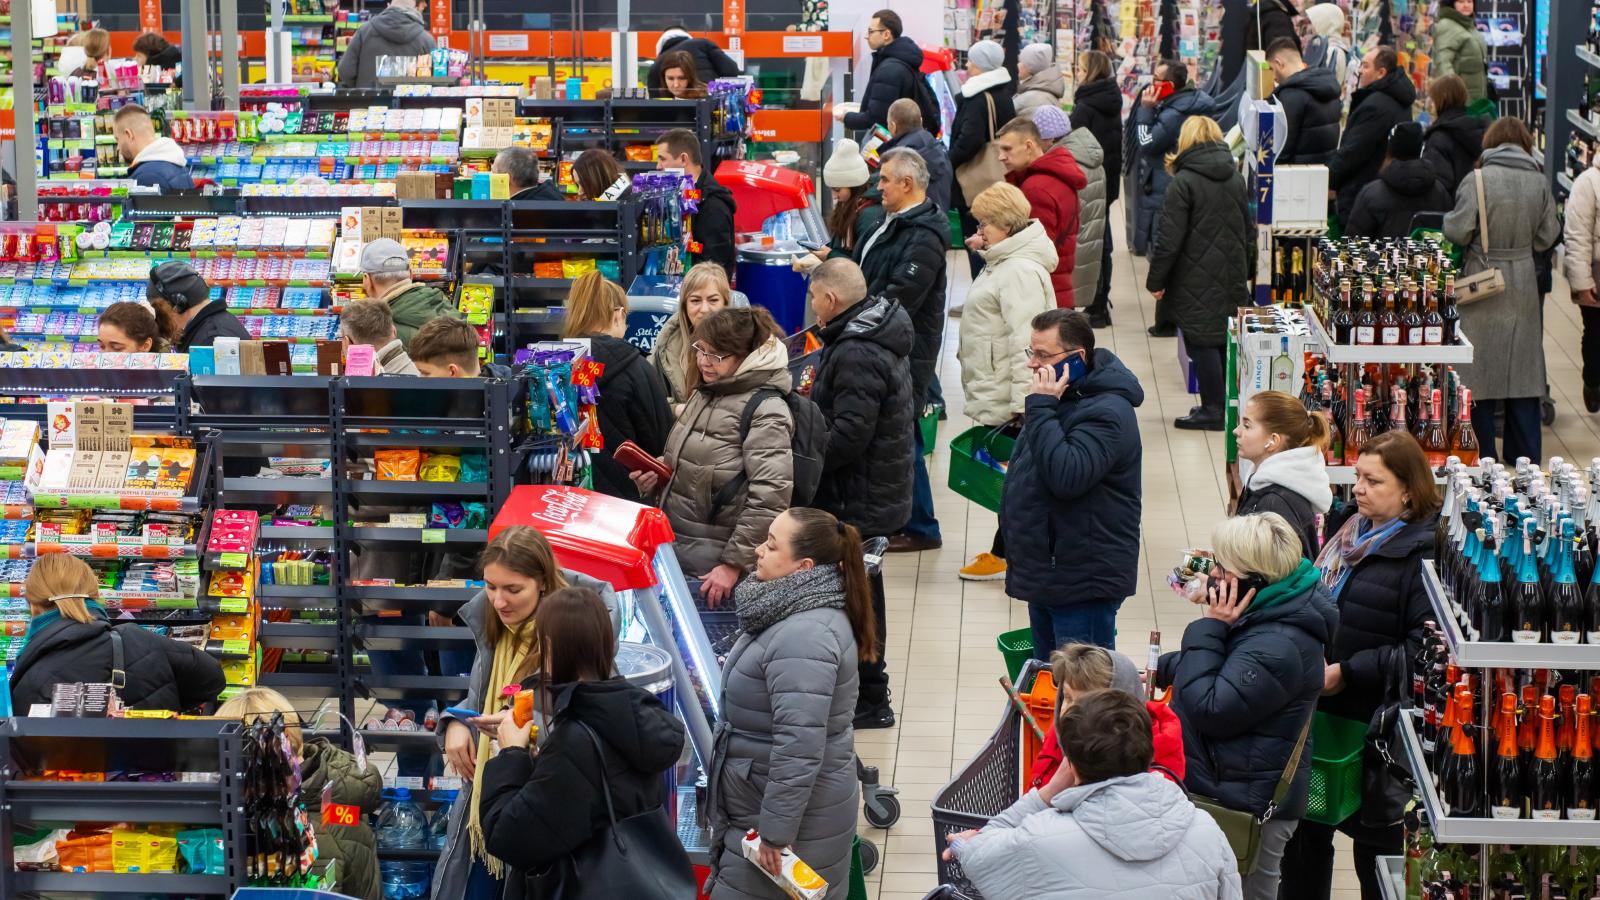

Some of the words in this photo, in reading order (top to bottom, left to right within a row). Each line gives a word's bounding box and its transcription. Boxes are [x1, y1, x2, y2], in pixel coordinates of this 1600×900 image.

[1260, 187, 1269, 203] 7
[587, 362, 600, 375] %
[1255, 360, 1263, 389] BIANCO
[577, 373, 590, 386] %
[531, 488, 590, 525] Coca-Cola
[335, 806, 353, 824] %
